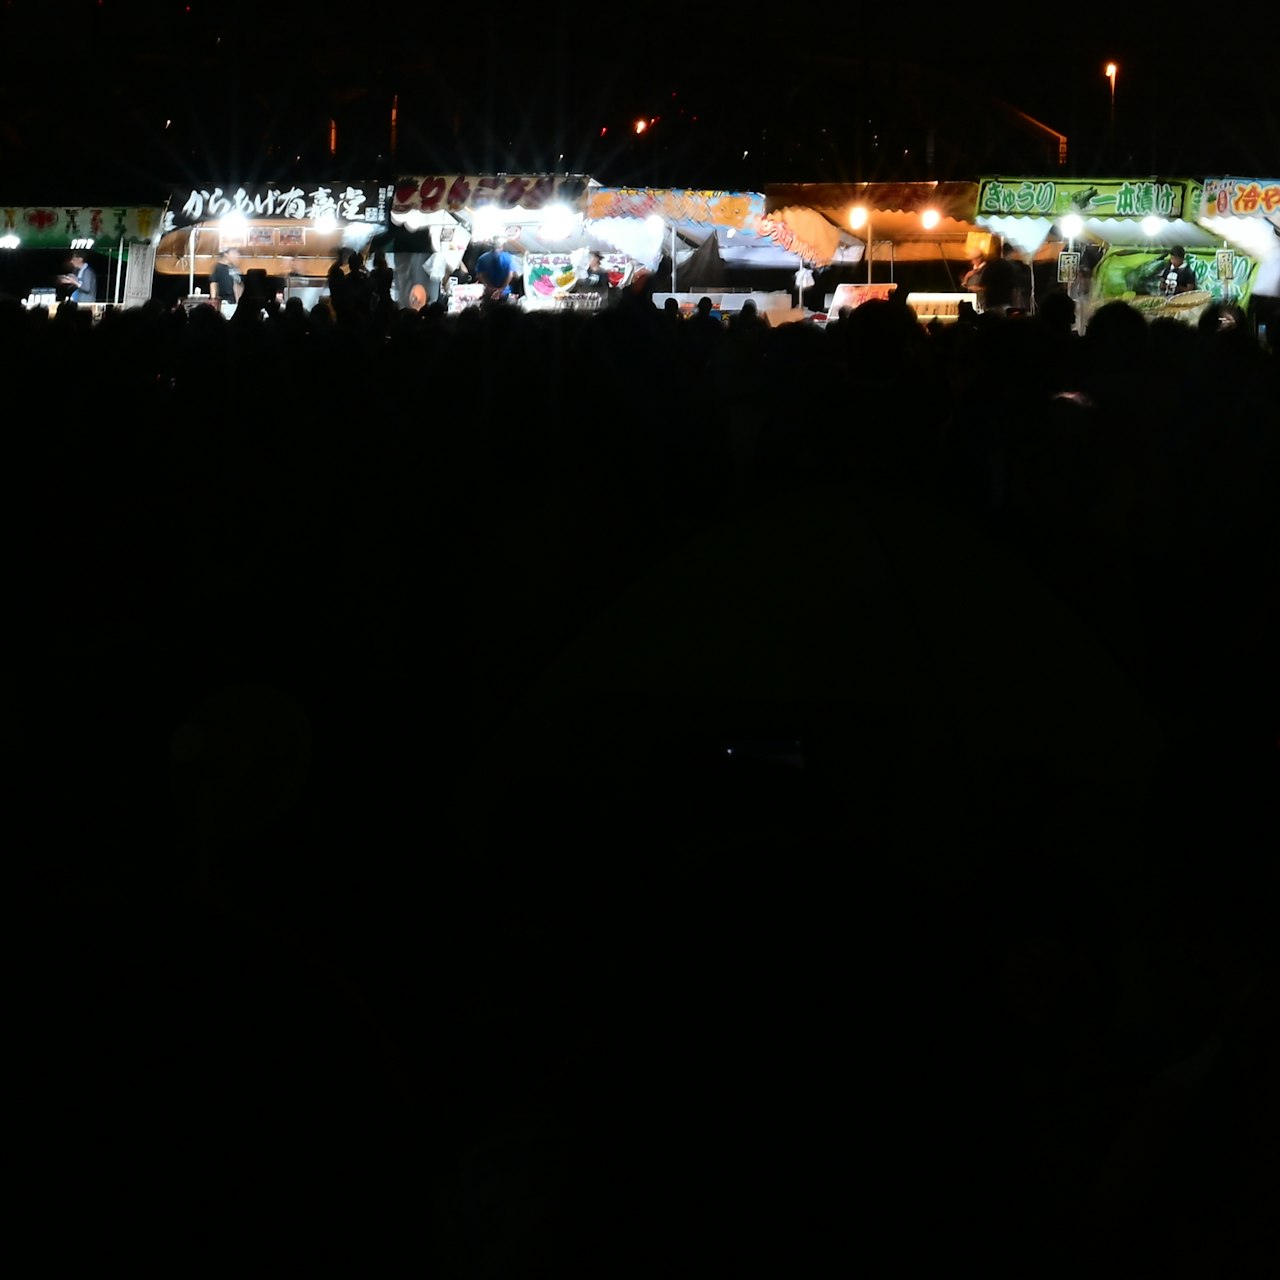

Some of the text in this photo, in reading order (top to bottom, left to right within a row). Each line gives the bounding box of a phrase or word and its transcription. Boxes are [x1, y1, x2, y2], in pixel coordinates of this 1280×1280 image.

[984, 181, 1056, 212] きゅうり
[1088, 181, 1176, 216] 一本漬け
